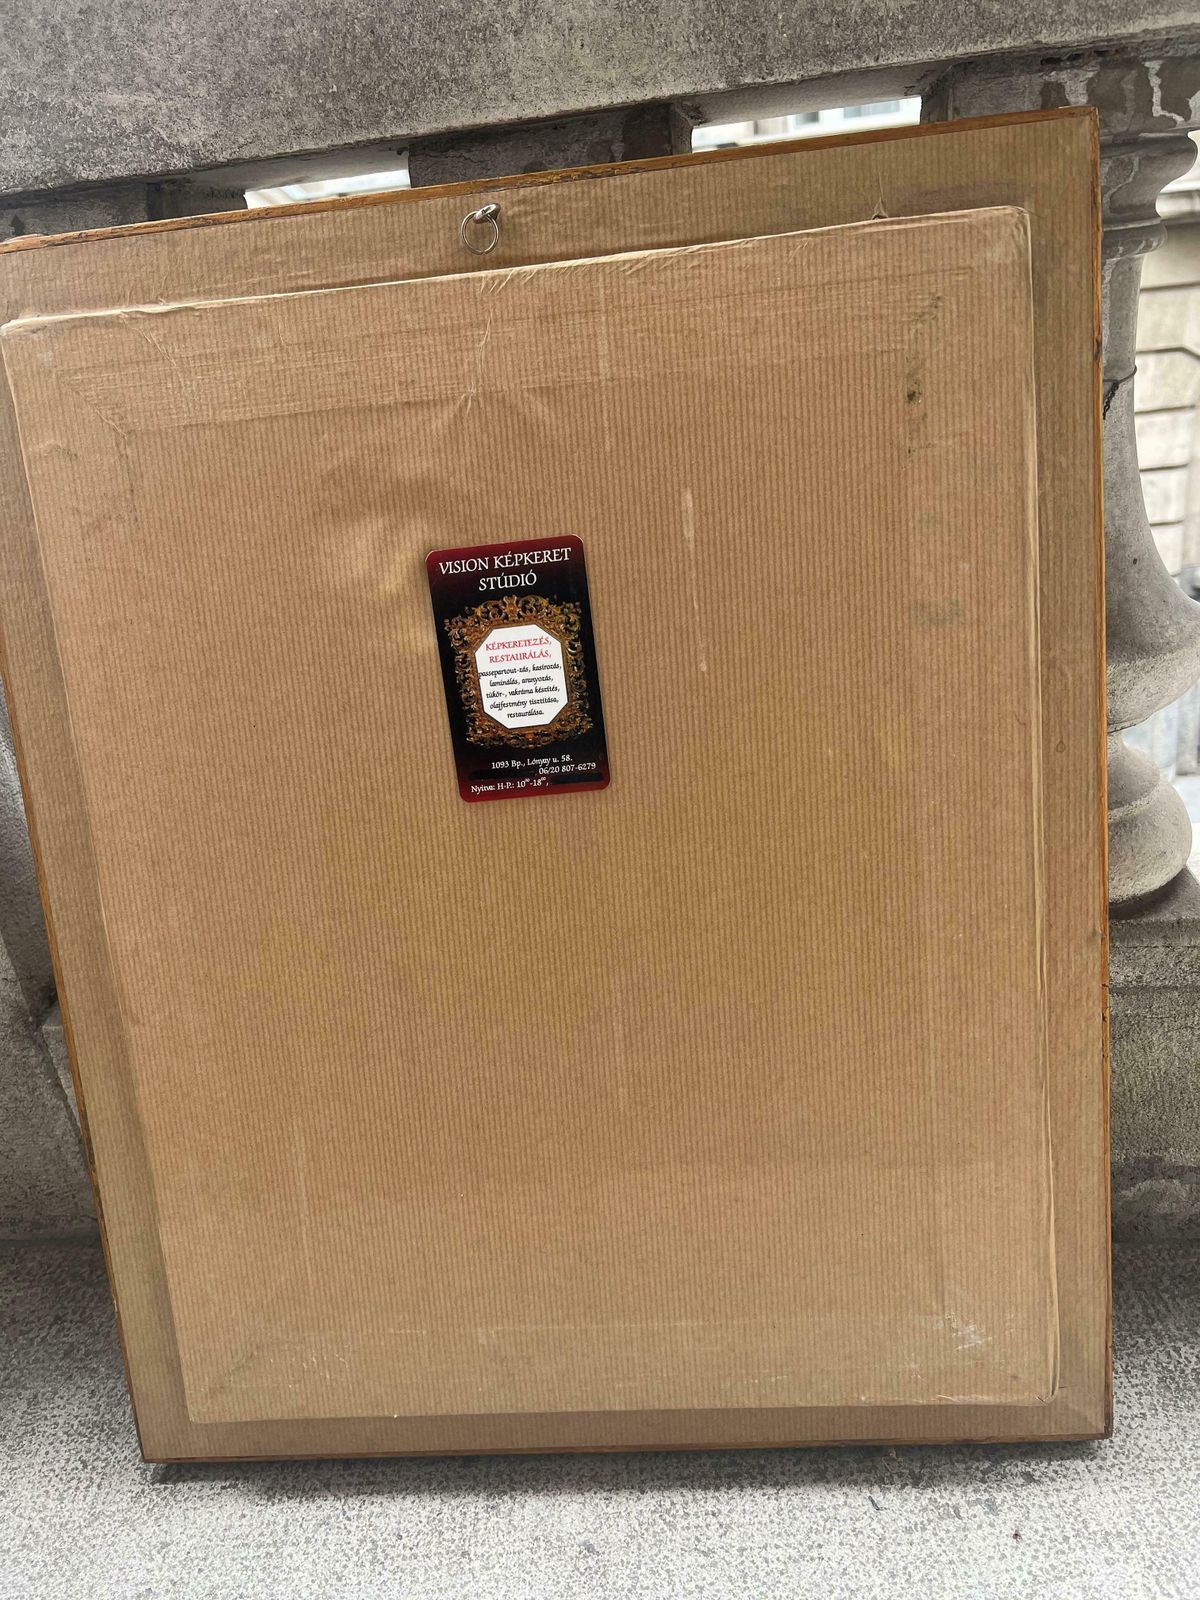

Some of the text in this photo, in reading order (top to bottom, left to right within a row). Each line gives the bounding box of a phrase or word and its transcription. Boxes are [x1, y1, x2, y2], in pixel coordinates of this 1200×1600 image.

[439, 547, 572, 575] VISION KÉPKERET
[478, 569, 537, 591] STÚDIÓ
[485, 637, 552, 651] KÉPKERETEZÉS,
[489, 649, 552, 664] RESTAURÁLÁS,
[490, 699, 528, 711] olajfestmény
[491, 762, 510, 770] 1093
[561, 754, 573, 762] 58.
[538, 762, 597, 775] 06/20 807-6279
